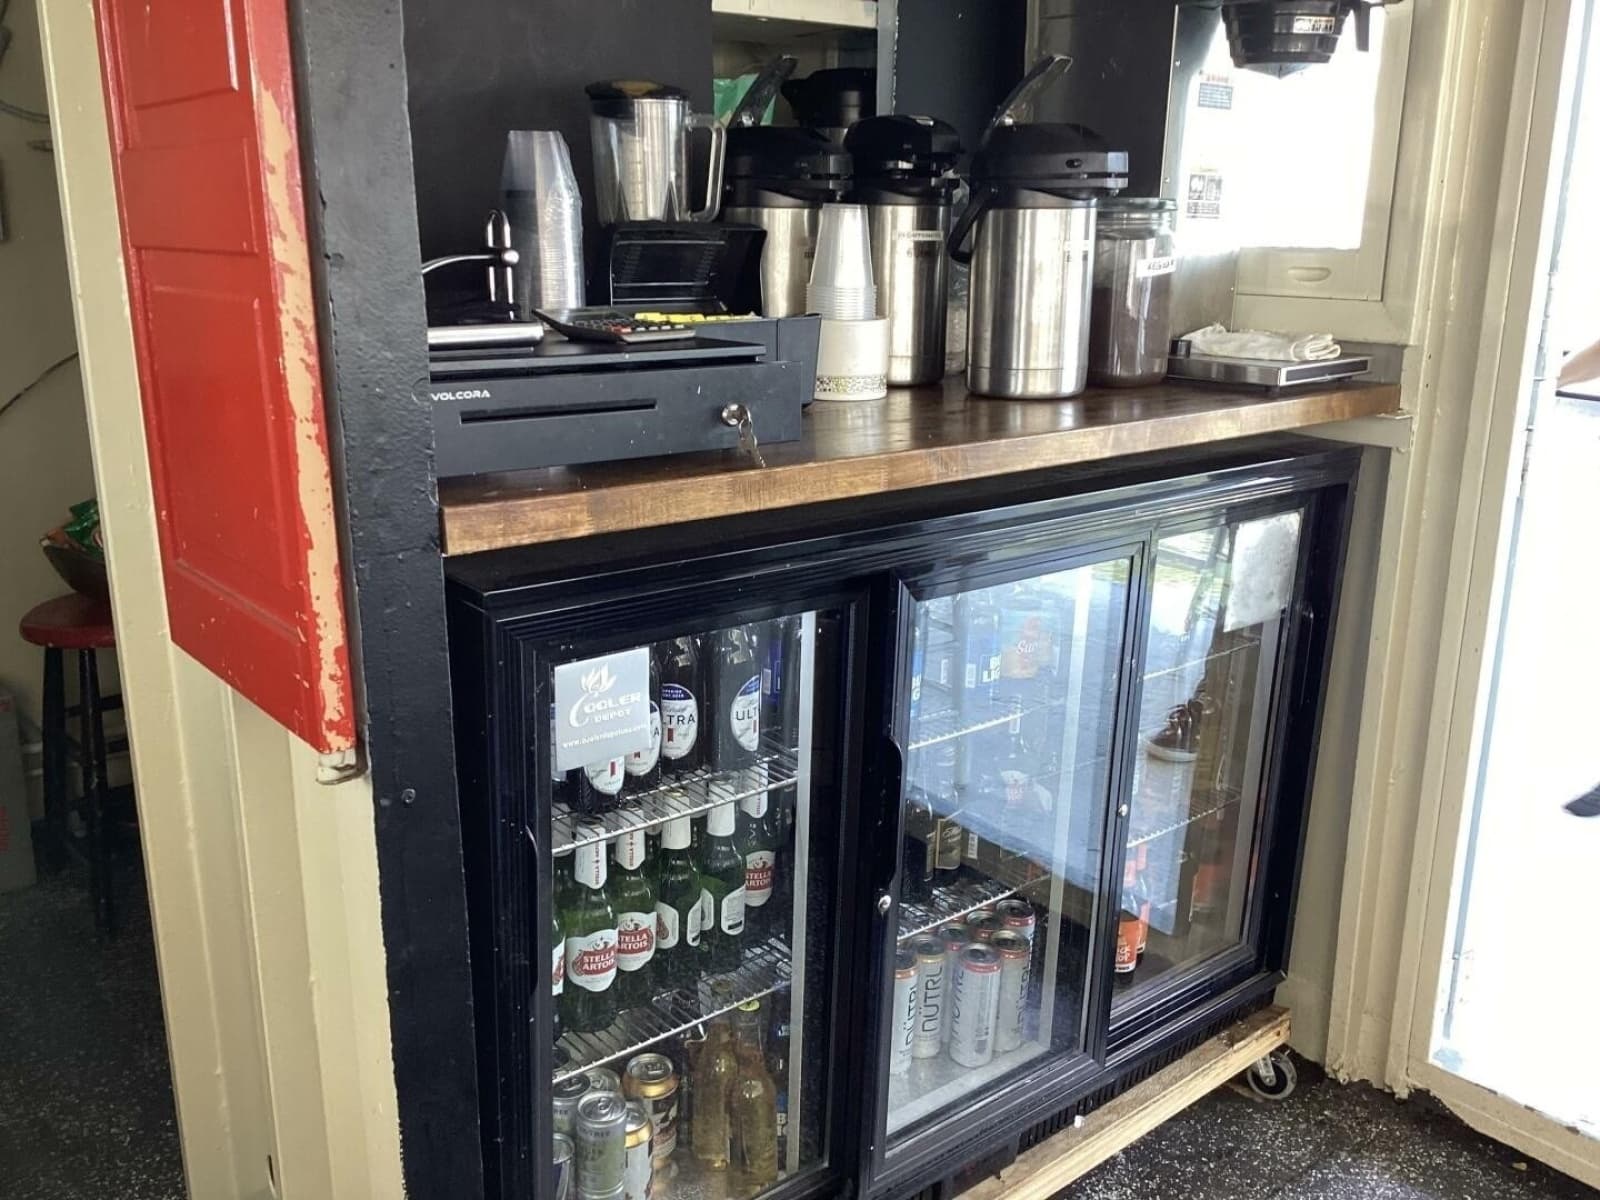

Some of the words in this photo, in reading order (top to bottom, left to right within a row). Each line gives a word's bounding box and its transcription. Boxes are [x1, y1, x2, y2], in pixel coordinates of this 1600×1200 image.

[430, 389, 491, 401] VOLCORA
[569, 691, 641, 729] COOLER
[592, 708, 632, 724] DEPOT
[620, 933, 648, 942] TELLA
